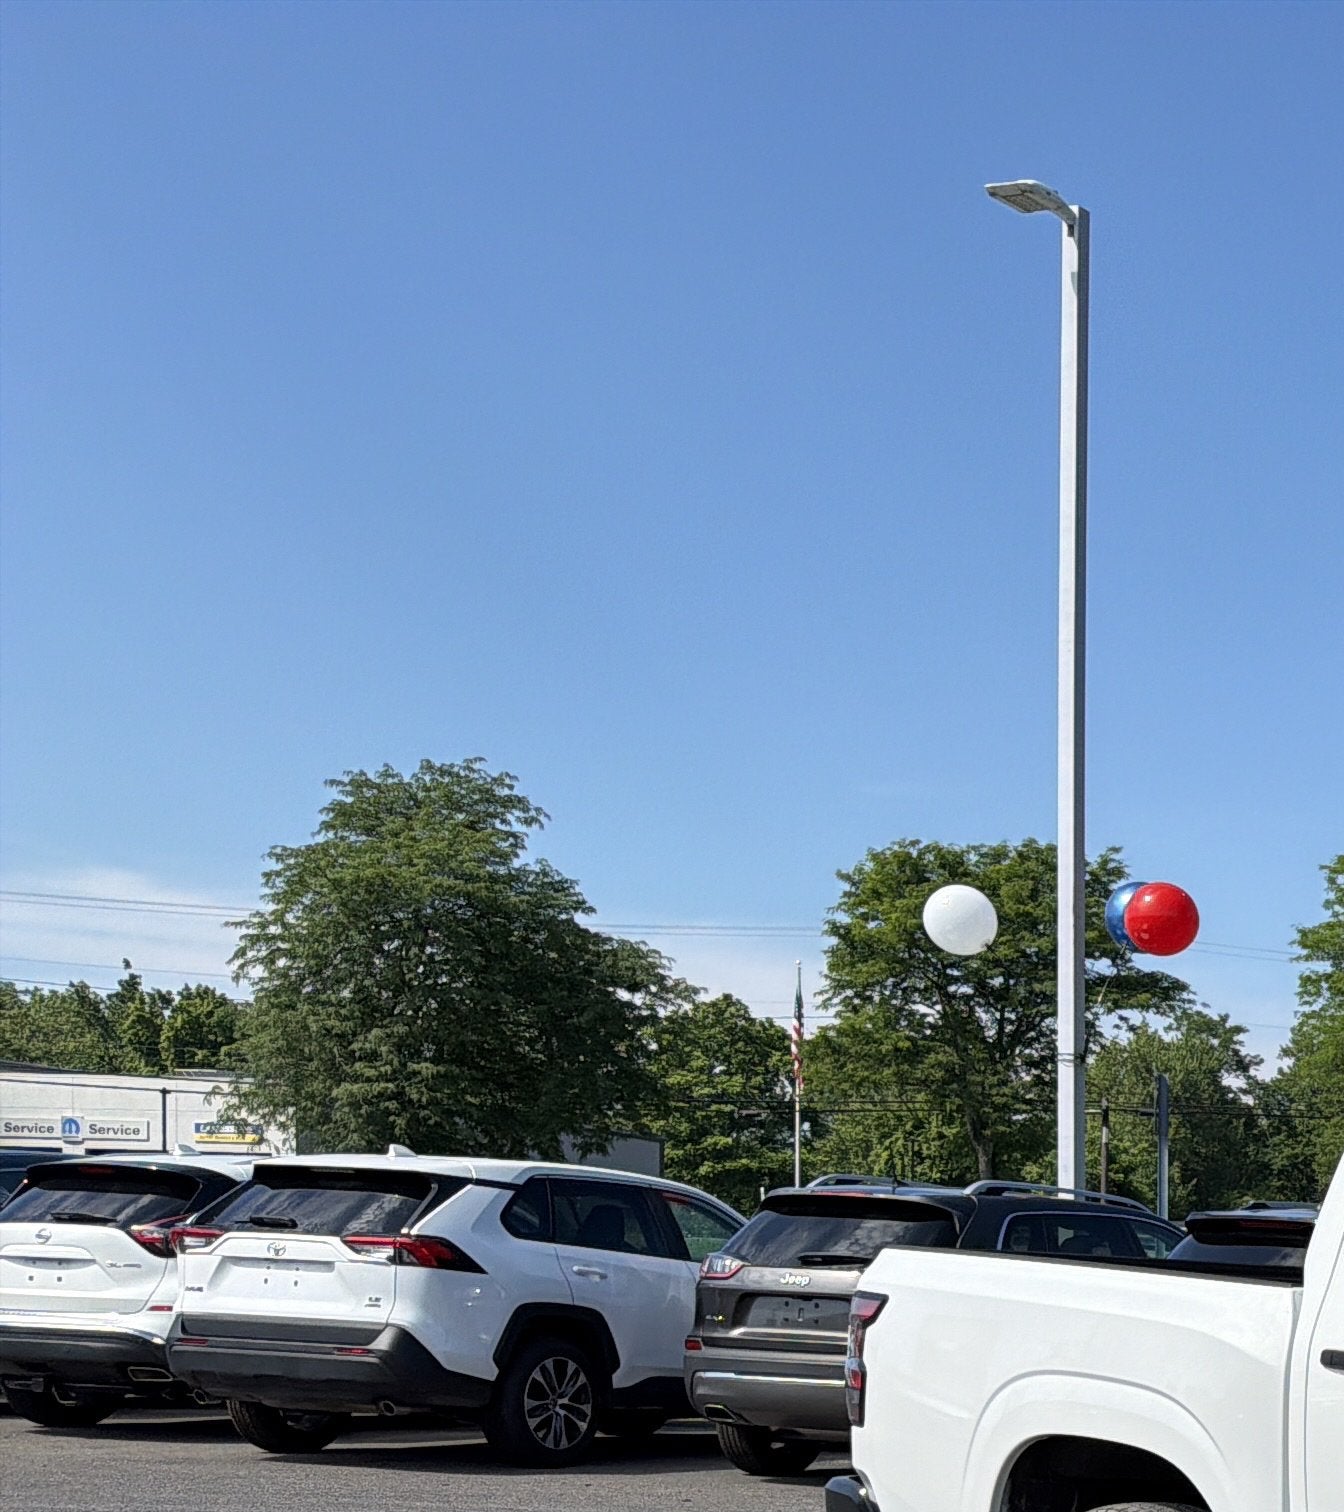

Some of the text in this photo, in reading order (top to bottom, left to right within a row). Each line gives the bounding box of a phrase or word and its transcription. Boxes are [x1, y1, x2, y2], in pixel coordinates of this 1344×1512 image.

[4, 1122, 55, 1134] Service
[88, 1123, 141, 1136] Service
[780, 1272, 811, 1287] Jeep
